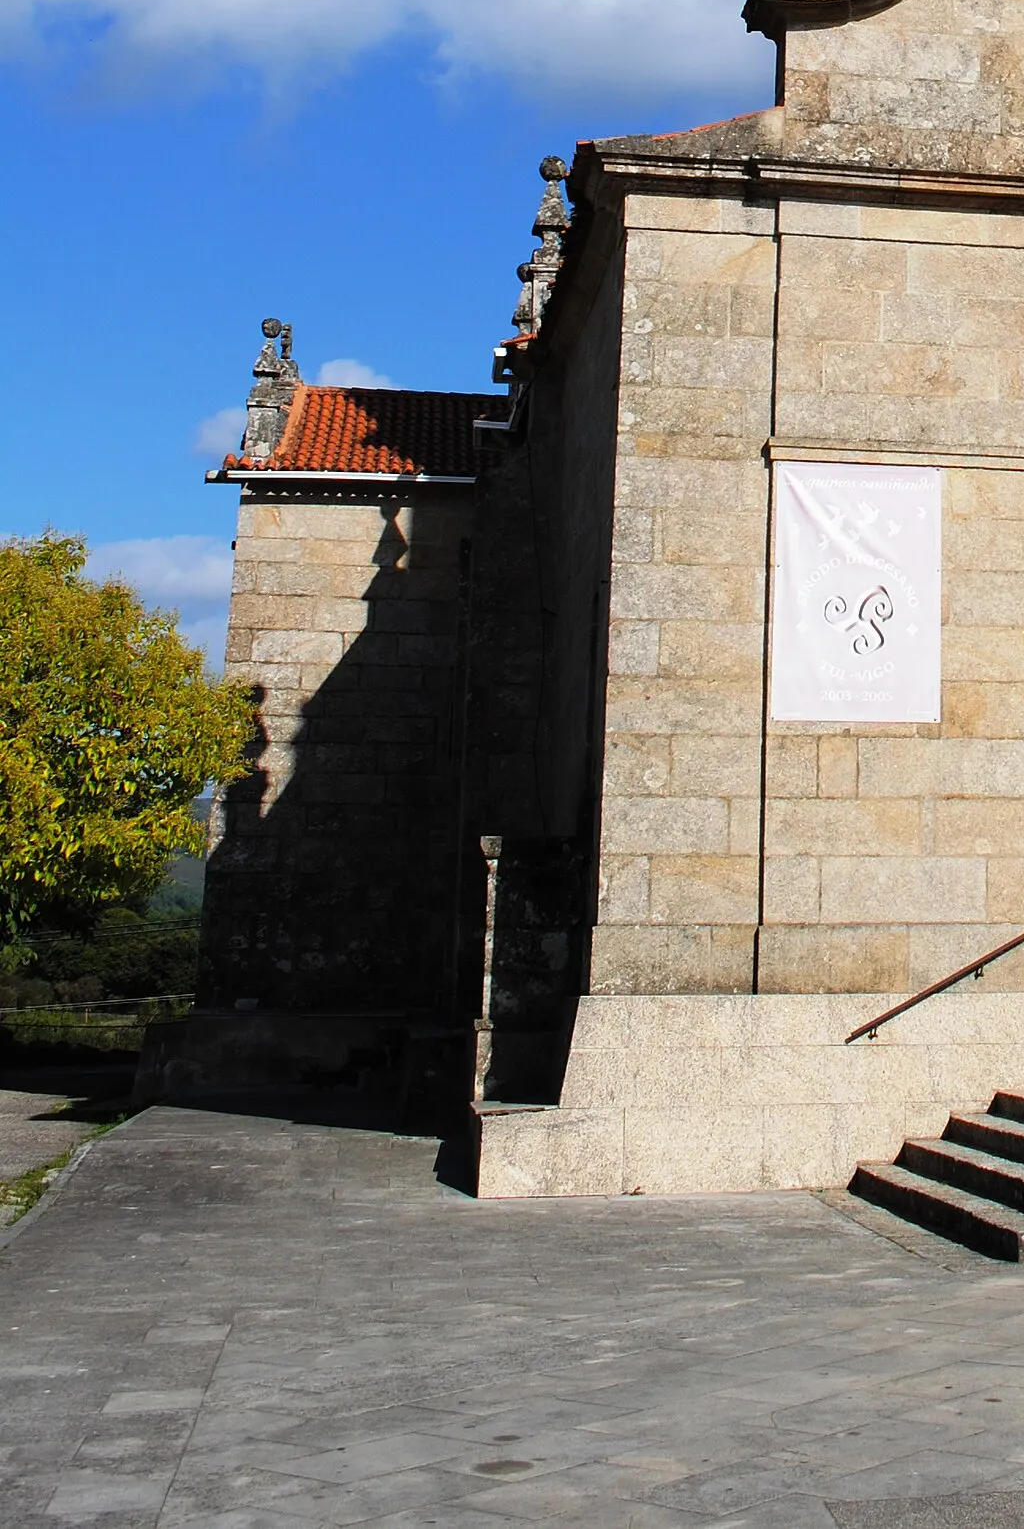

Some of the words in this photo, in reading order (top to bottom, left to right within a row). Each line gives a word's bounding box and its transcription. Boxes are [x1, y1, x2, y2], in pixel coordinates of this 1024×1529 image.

[846, 554, 919, 607] DIOCESANO
[820, 659, 846, 681] TUI
[855, 660, 895, 681] VIGO
[820, 690, 852, 702] 2003
[861, 690, 894, 702] 2005
